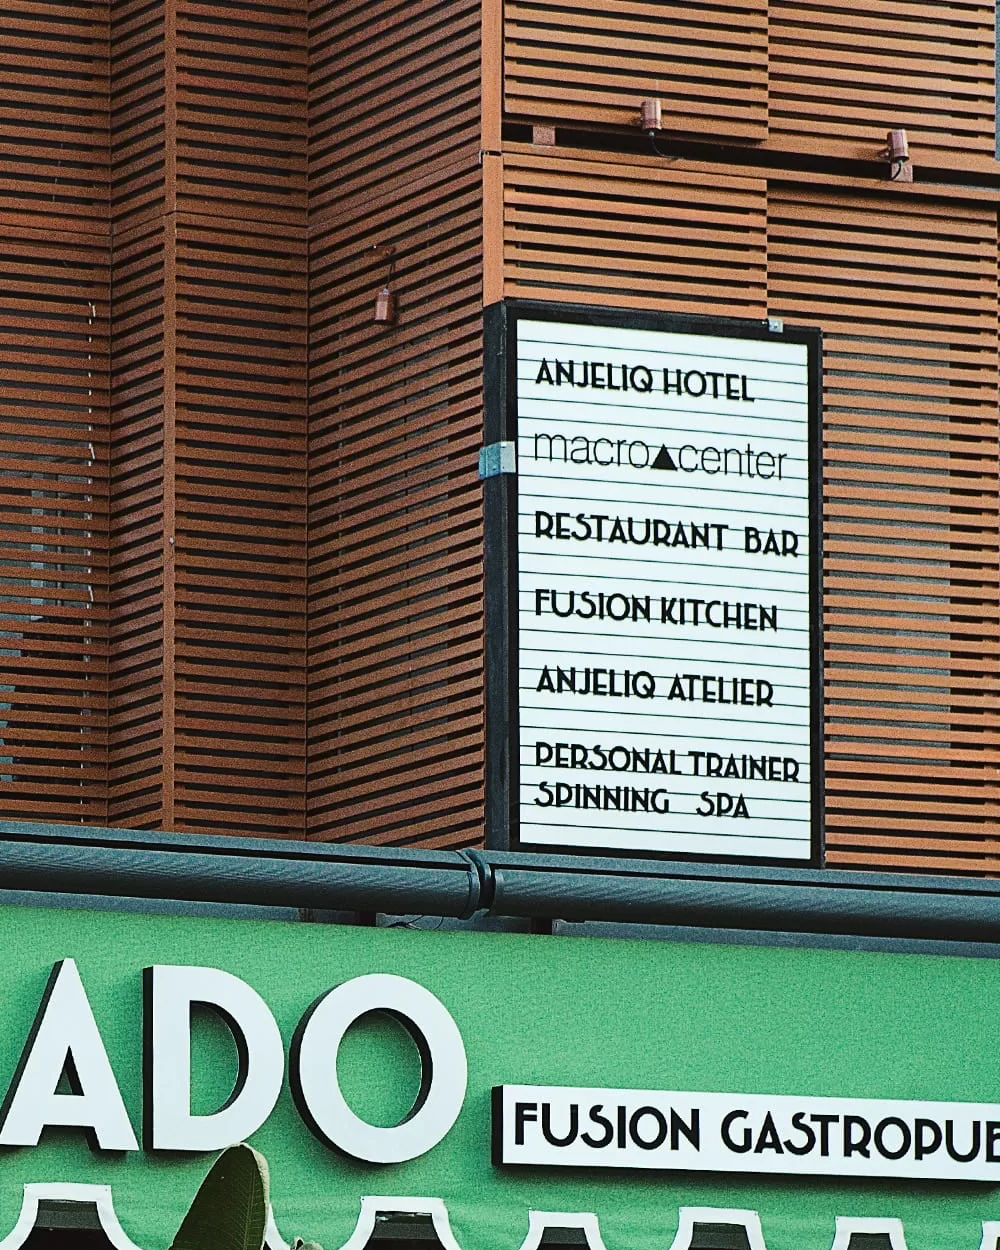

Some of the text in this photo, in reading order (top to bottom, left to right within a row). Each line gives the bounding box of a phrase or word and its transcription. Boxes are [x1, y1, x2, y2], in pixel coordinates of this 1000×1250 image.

[535, 358, 755, 402] ANJELIQ HOTEL
[535, 511, 799, 557] RESTAURANT BAR
[535, 589, 778, 632] FUSION KITCHEN
[536, 665, 774, 707] ANJELIQ ATELIER
[535, 742, 800, 783] PERSONAL TRAINER
[534, 782, 750, 818] SPINNING SPA
[514, 1102, 700, 1152] FUSION
